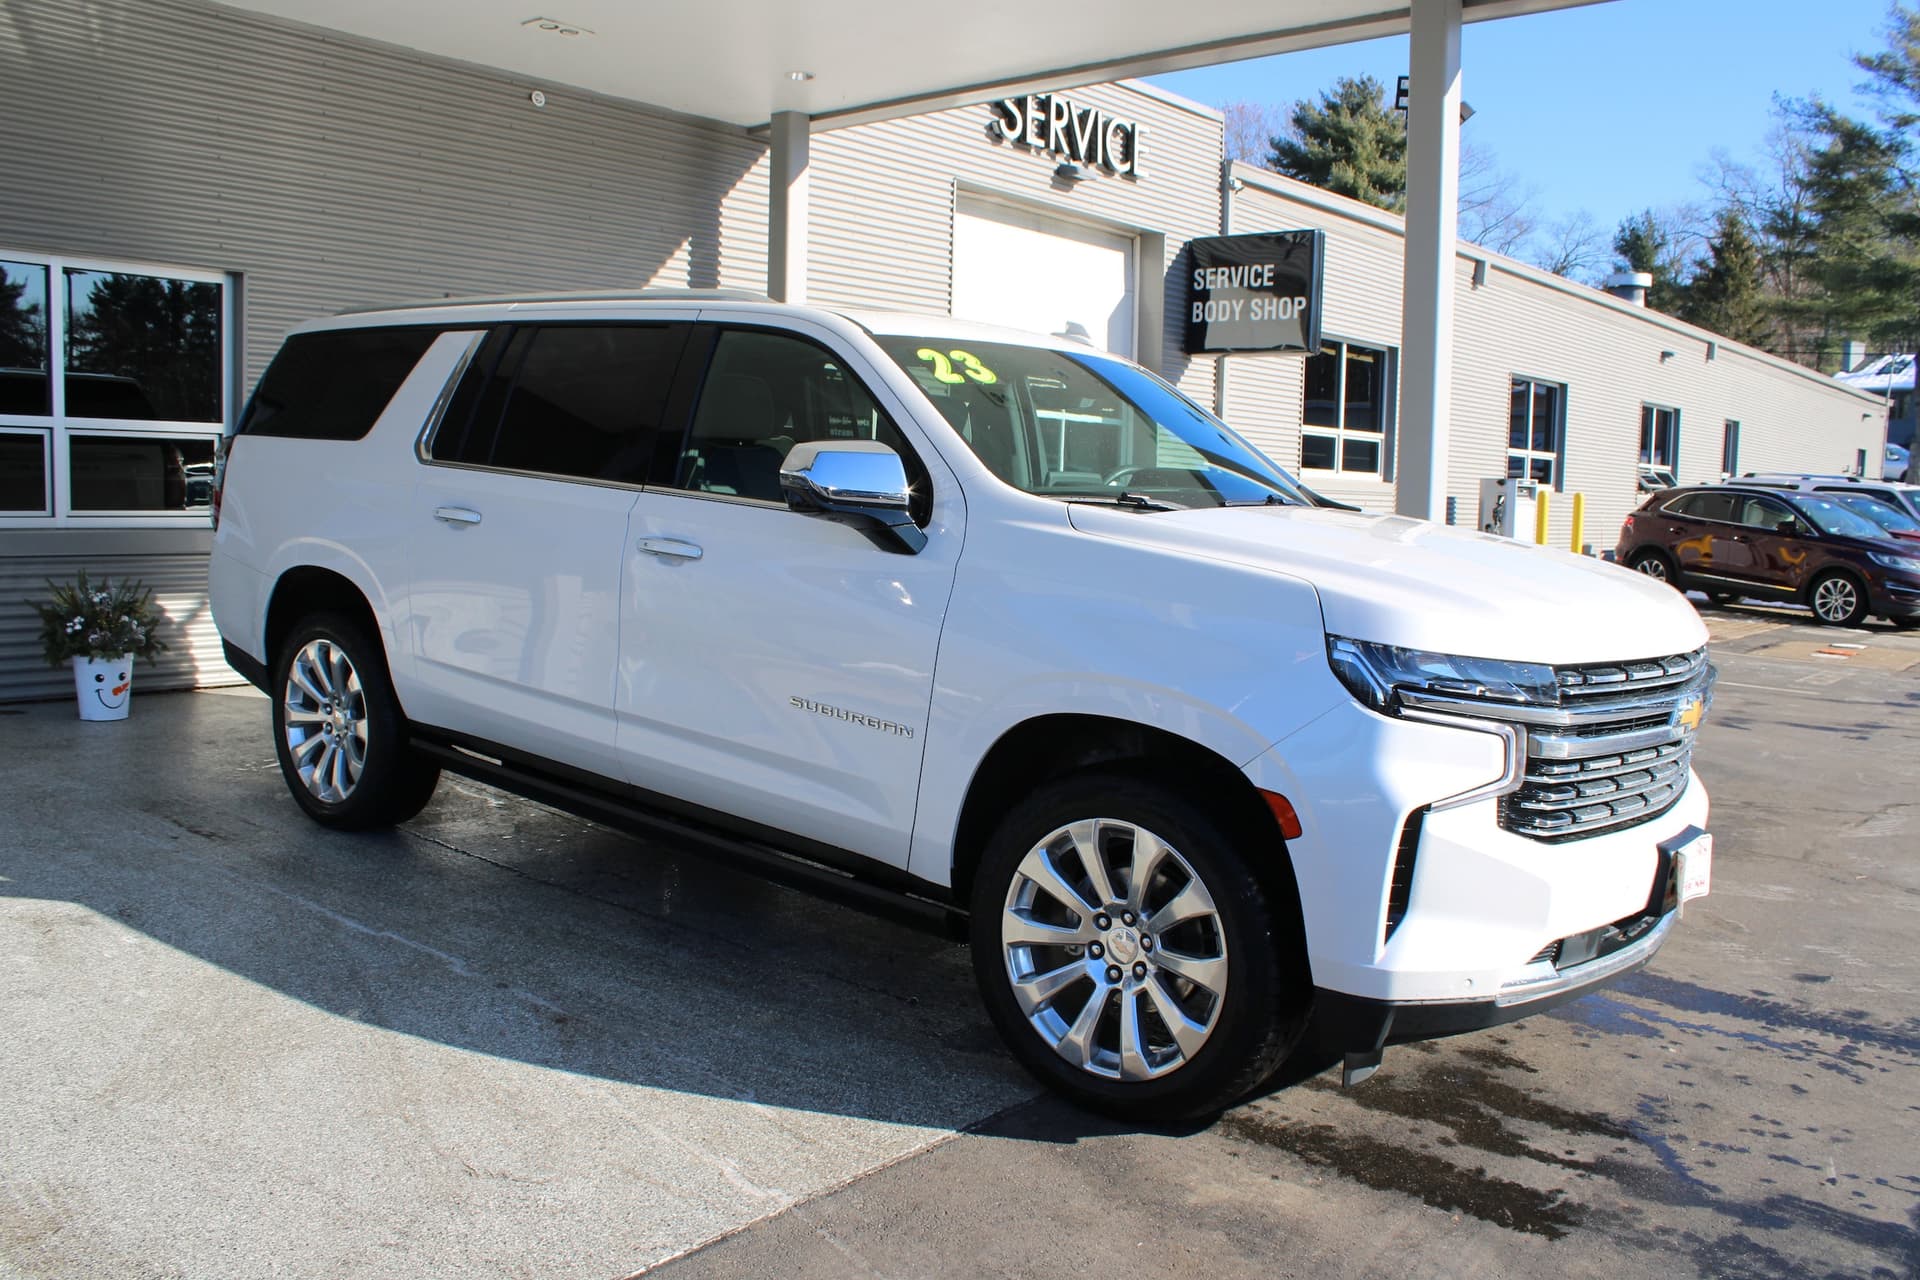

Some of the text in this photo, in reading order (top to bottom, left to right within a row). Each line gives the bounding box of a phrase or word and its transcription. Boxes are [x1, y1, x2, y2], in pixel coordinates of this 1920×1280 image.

[1000, 94, 1150, 178] SERVICE
[1193, 264, 1275, 290] SERVICE
[1192, 297, 1307, 323] BODY SHOP
[916, 348, 997, 385] 23
[789, 695, 914, 738] SUBURBAN
